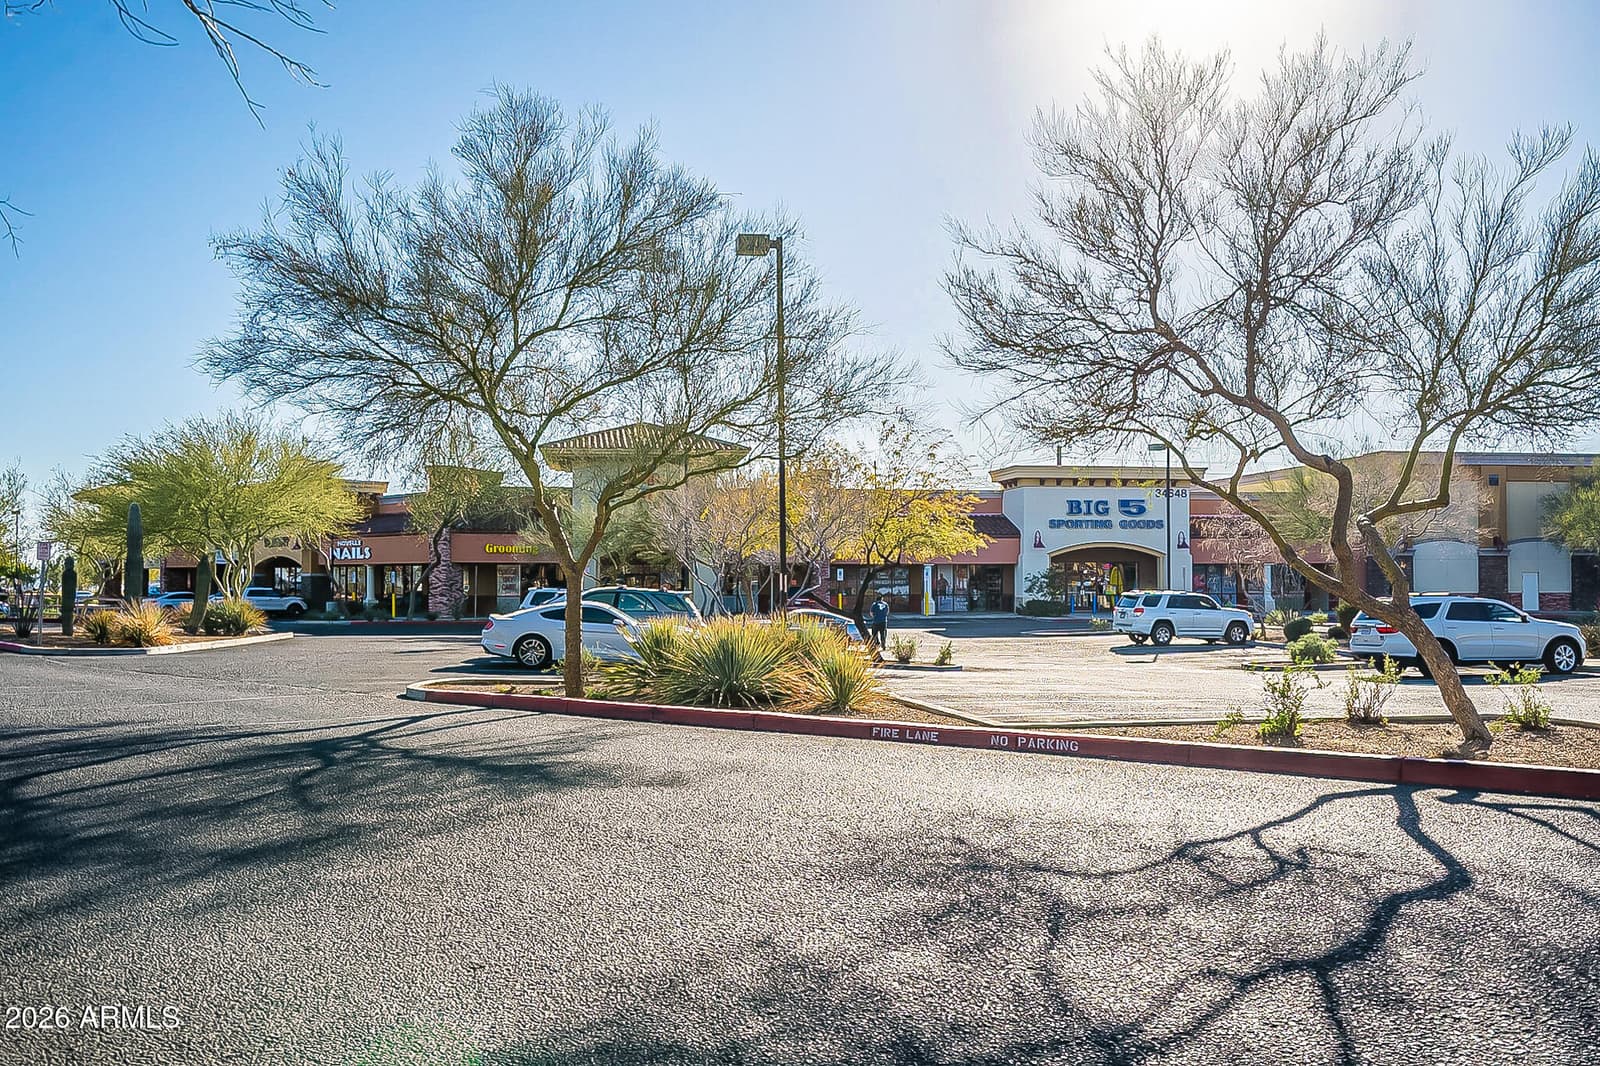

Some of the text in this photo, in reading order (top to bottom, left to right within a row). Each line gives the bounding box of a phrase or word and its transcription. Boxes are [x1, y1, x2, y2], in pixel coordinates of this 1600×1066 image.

[1154, 488, 1188, 498] 34648
[1066, 499, 1147, 517] BIG 5
[1048, 519, 1164, 529] SPORTING GOODS
[330, 546, 372, 560] NAILS
[872, 727, 939, 742] FIRE LANE
[990, 735, 1079, 751] NO PARKING
